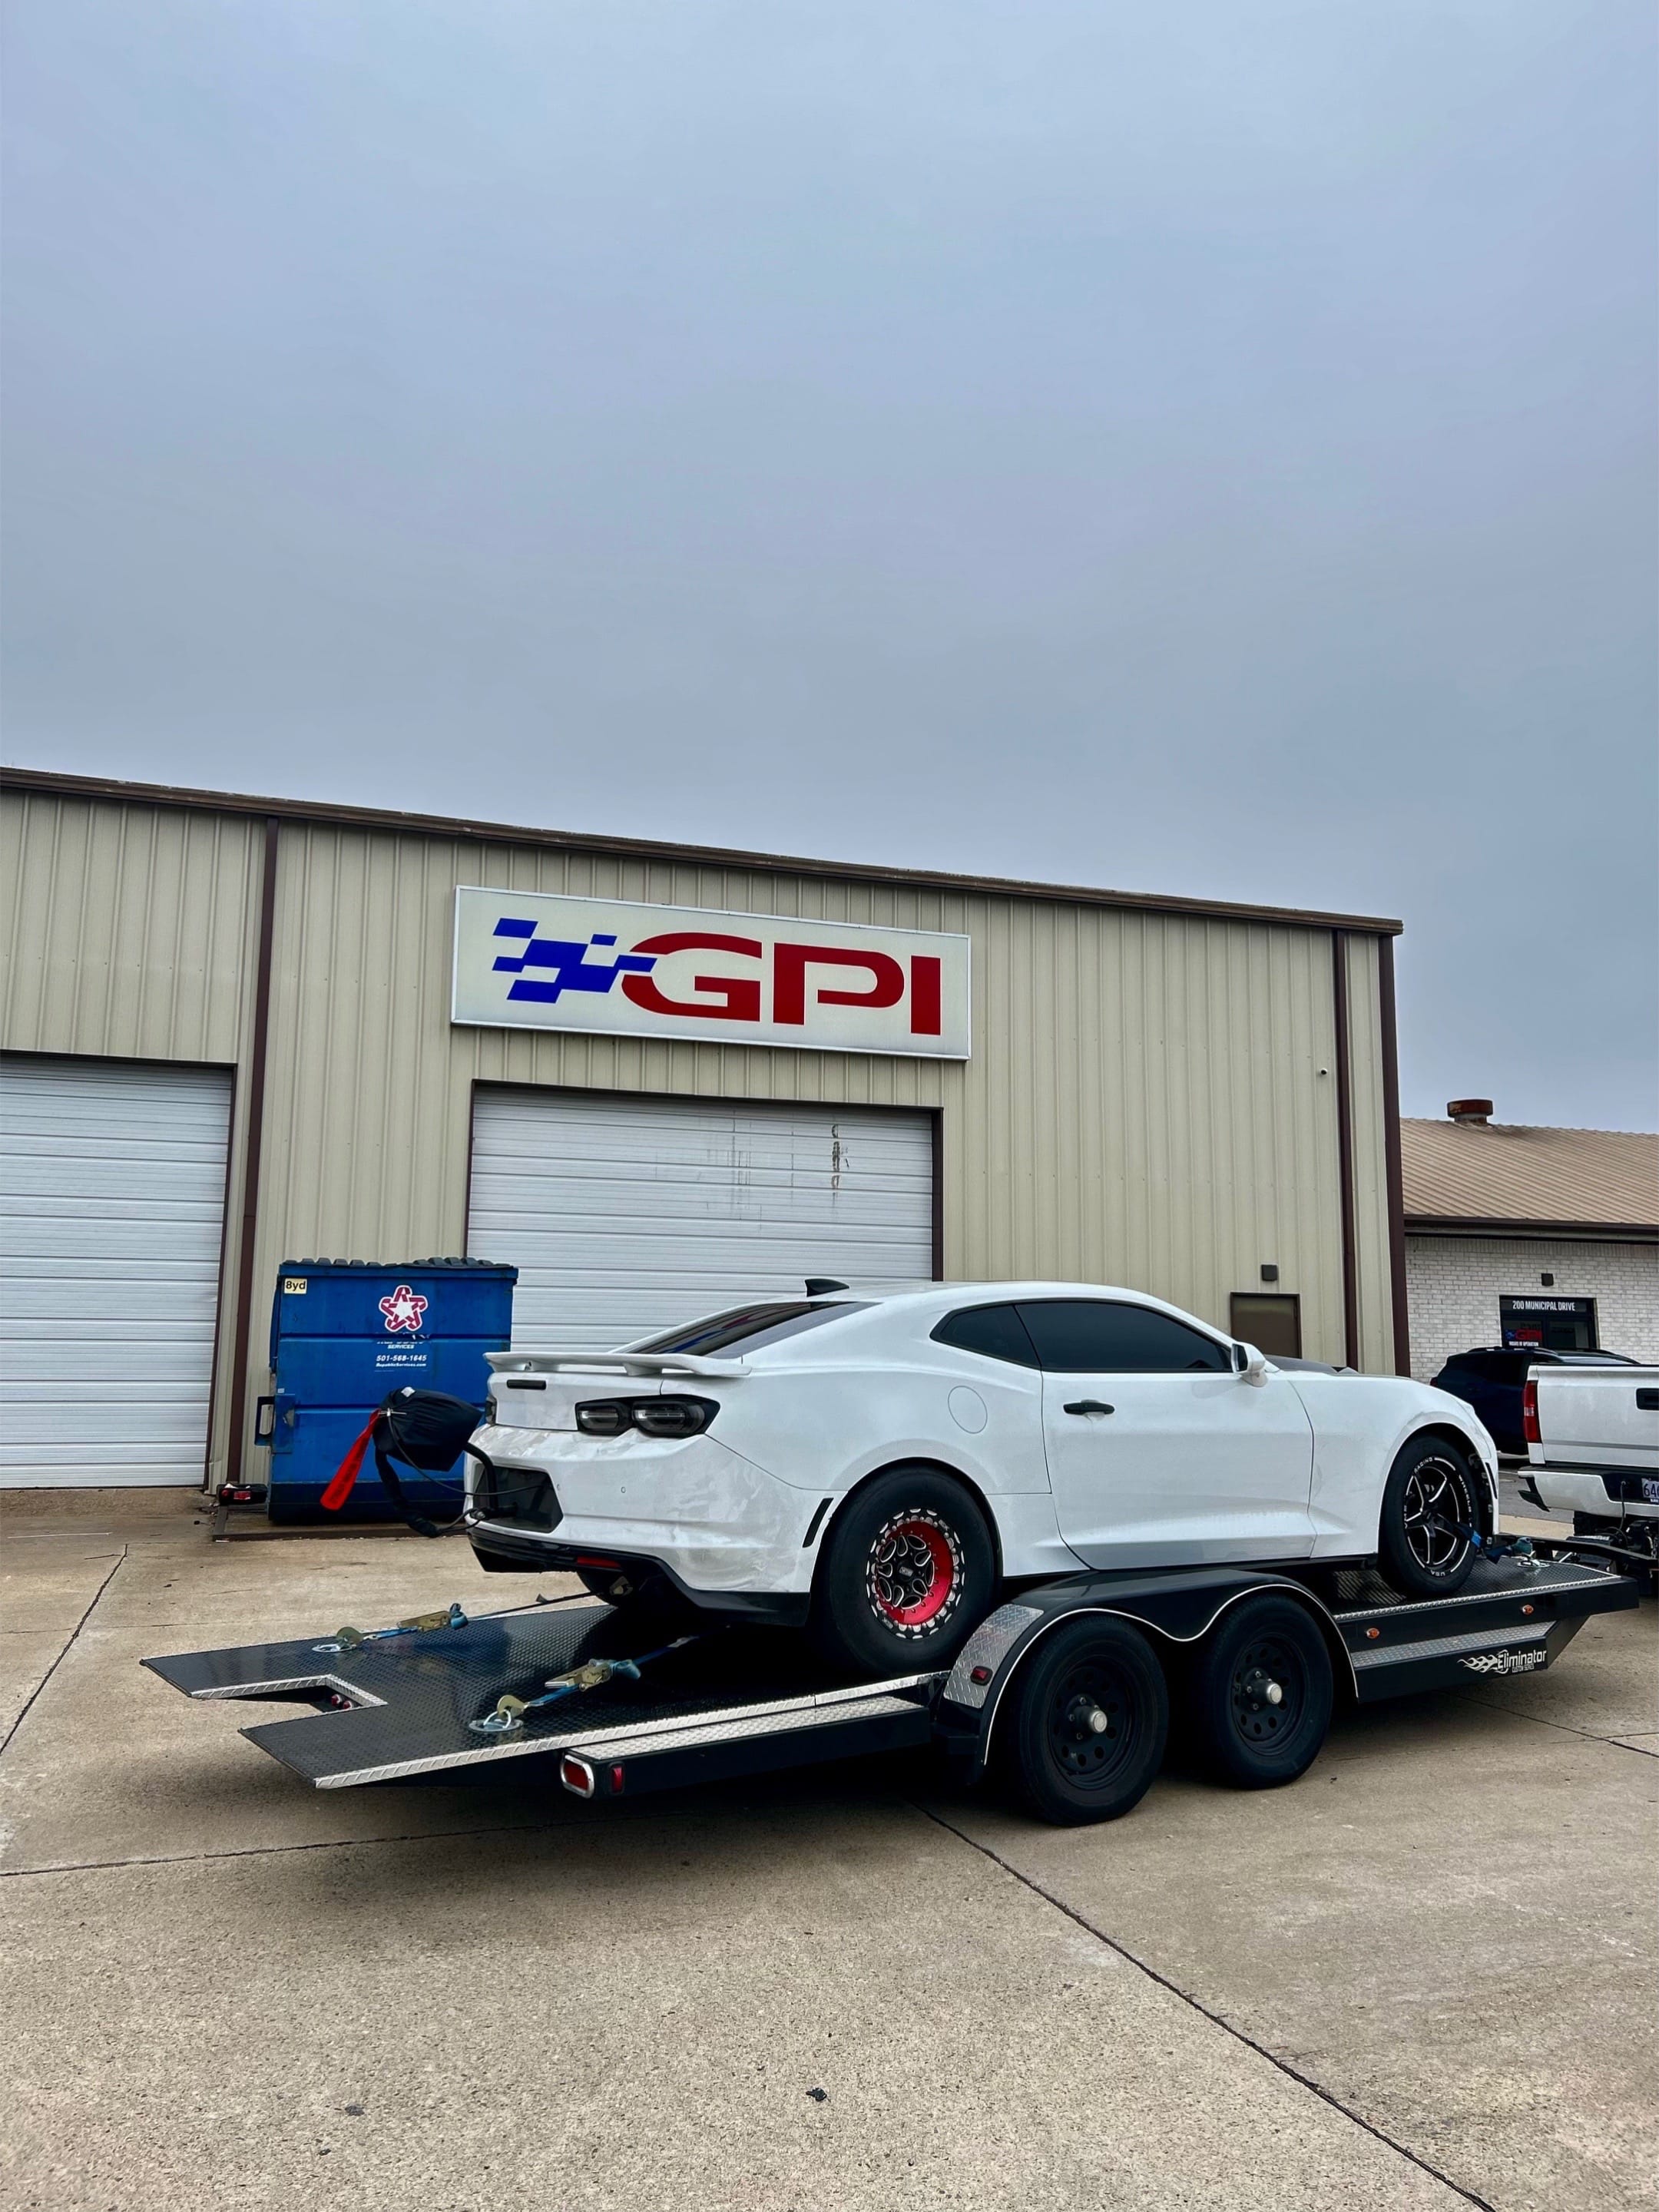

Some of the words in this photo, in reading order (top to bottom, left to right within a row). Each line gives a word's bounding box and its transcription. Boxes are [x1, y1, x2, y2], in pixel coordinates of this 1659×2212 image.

[621, 931, 942, 1036] GPI
[286, 1280, 306, 1291] 8yd
[1512, 1300, 1525, 1310] 200
[1525, 1300, 1558, 1311] MUNICIPAL
[1558, 1301, 1575, 1312] DRIVE
[1497, 1649, 1548, 1669] Eliminator
